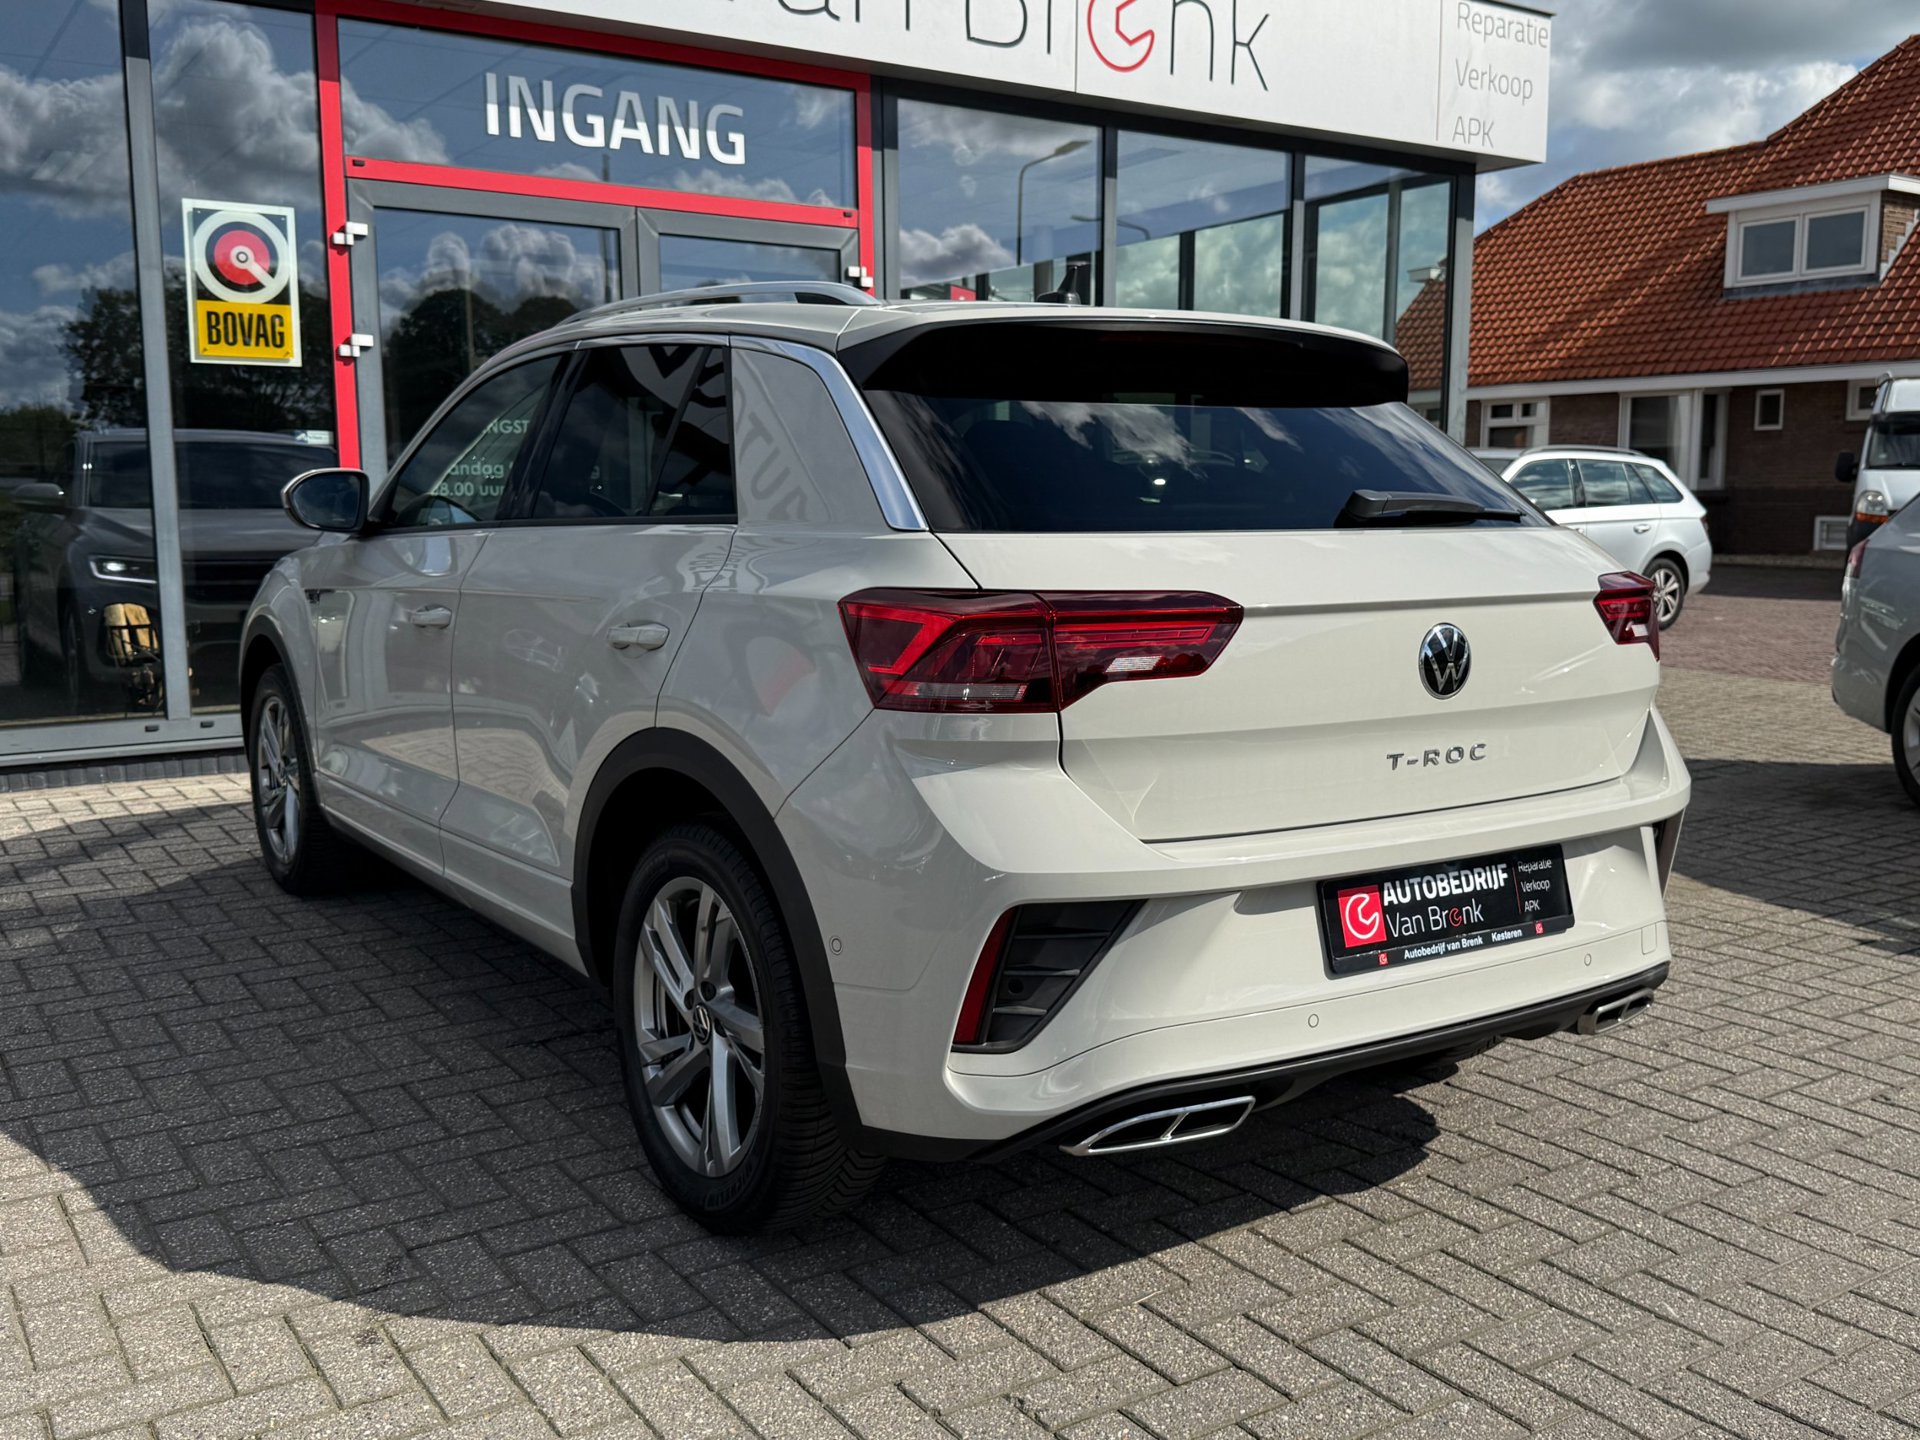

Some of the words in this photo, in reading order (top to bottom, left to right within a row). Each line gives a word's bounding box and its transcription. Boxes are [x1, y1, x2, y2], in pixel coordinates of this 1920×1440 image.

[1457, 2, 1549, 49] Reparatie
[1455, 57, 1534, 106] Verkoop
[485, 71, 746, 165] INGANG
[1451, 115, 1495, 149] APK
[206, 310, 285, 349] BOVAG
[1386, 743, 1487, 771] T-ROC
[1383, 863, 1508, 906] AUTOBEDRIJF
[1520, 879, 1551, 892] Verkoop
[1386, 912, 1425, 937] Van
[1427, 898, 1484, 931] Brenk
[1524, 899, 1541, 912] APK
[1403, 942, 1446, 960] Autobedrijf
[1446, 938, 1461, 951] van
[1461, 935, 1484, 948] Brenk
[1491, 929, 1523, 942] Kesteren
